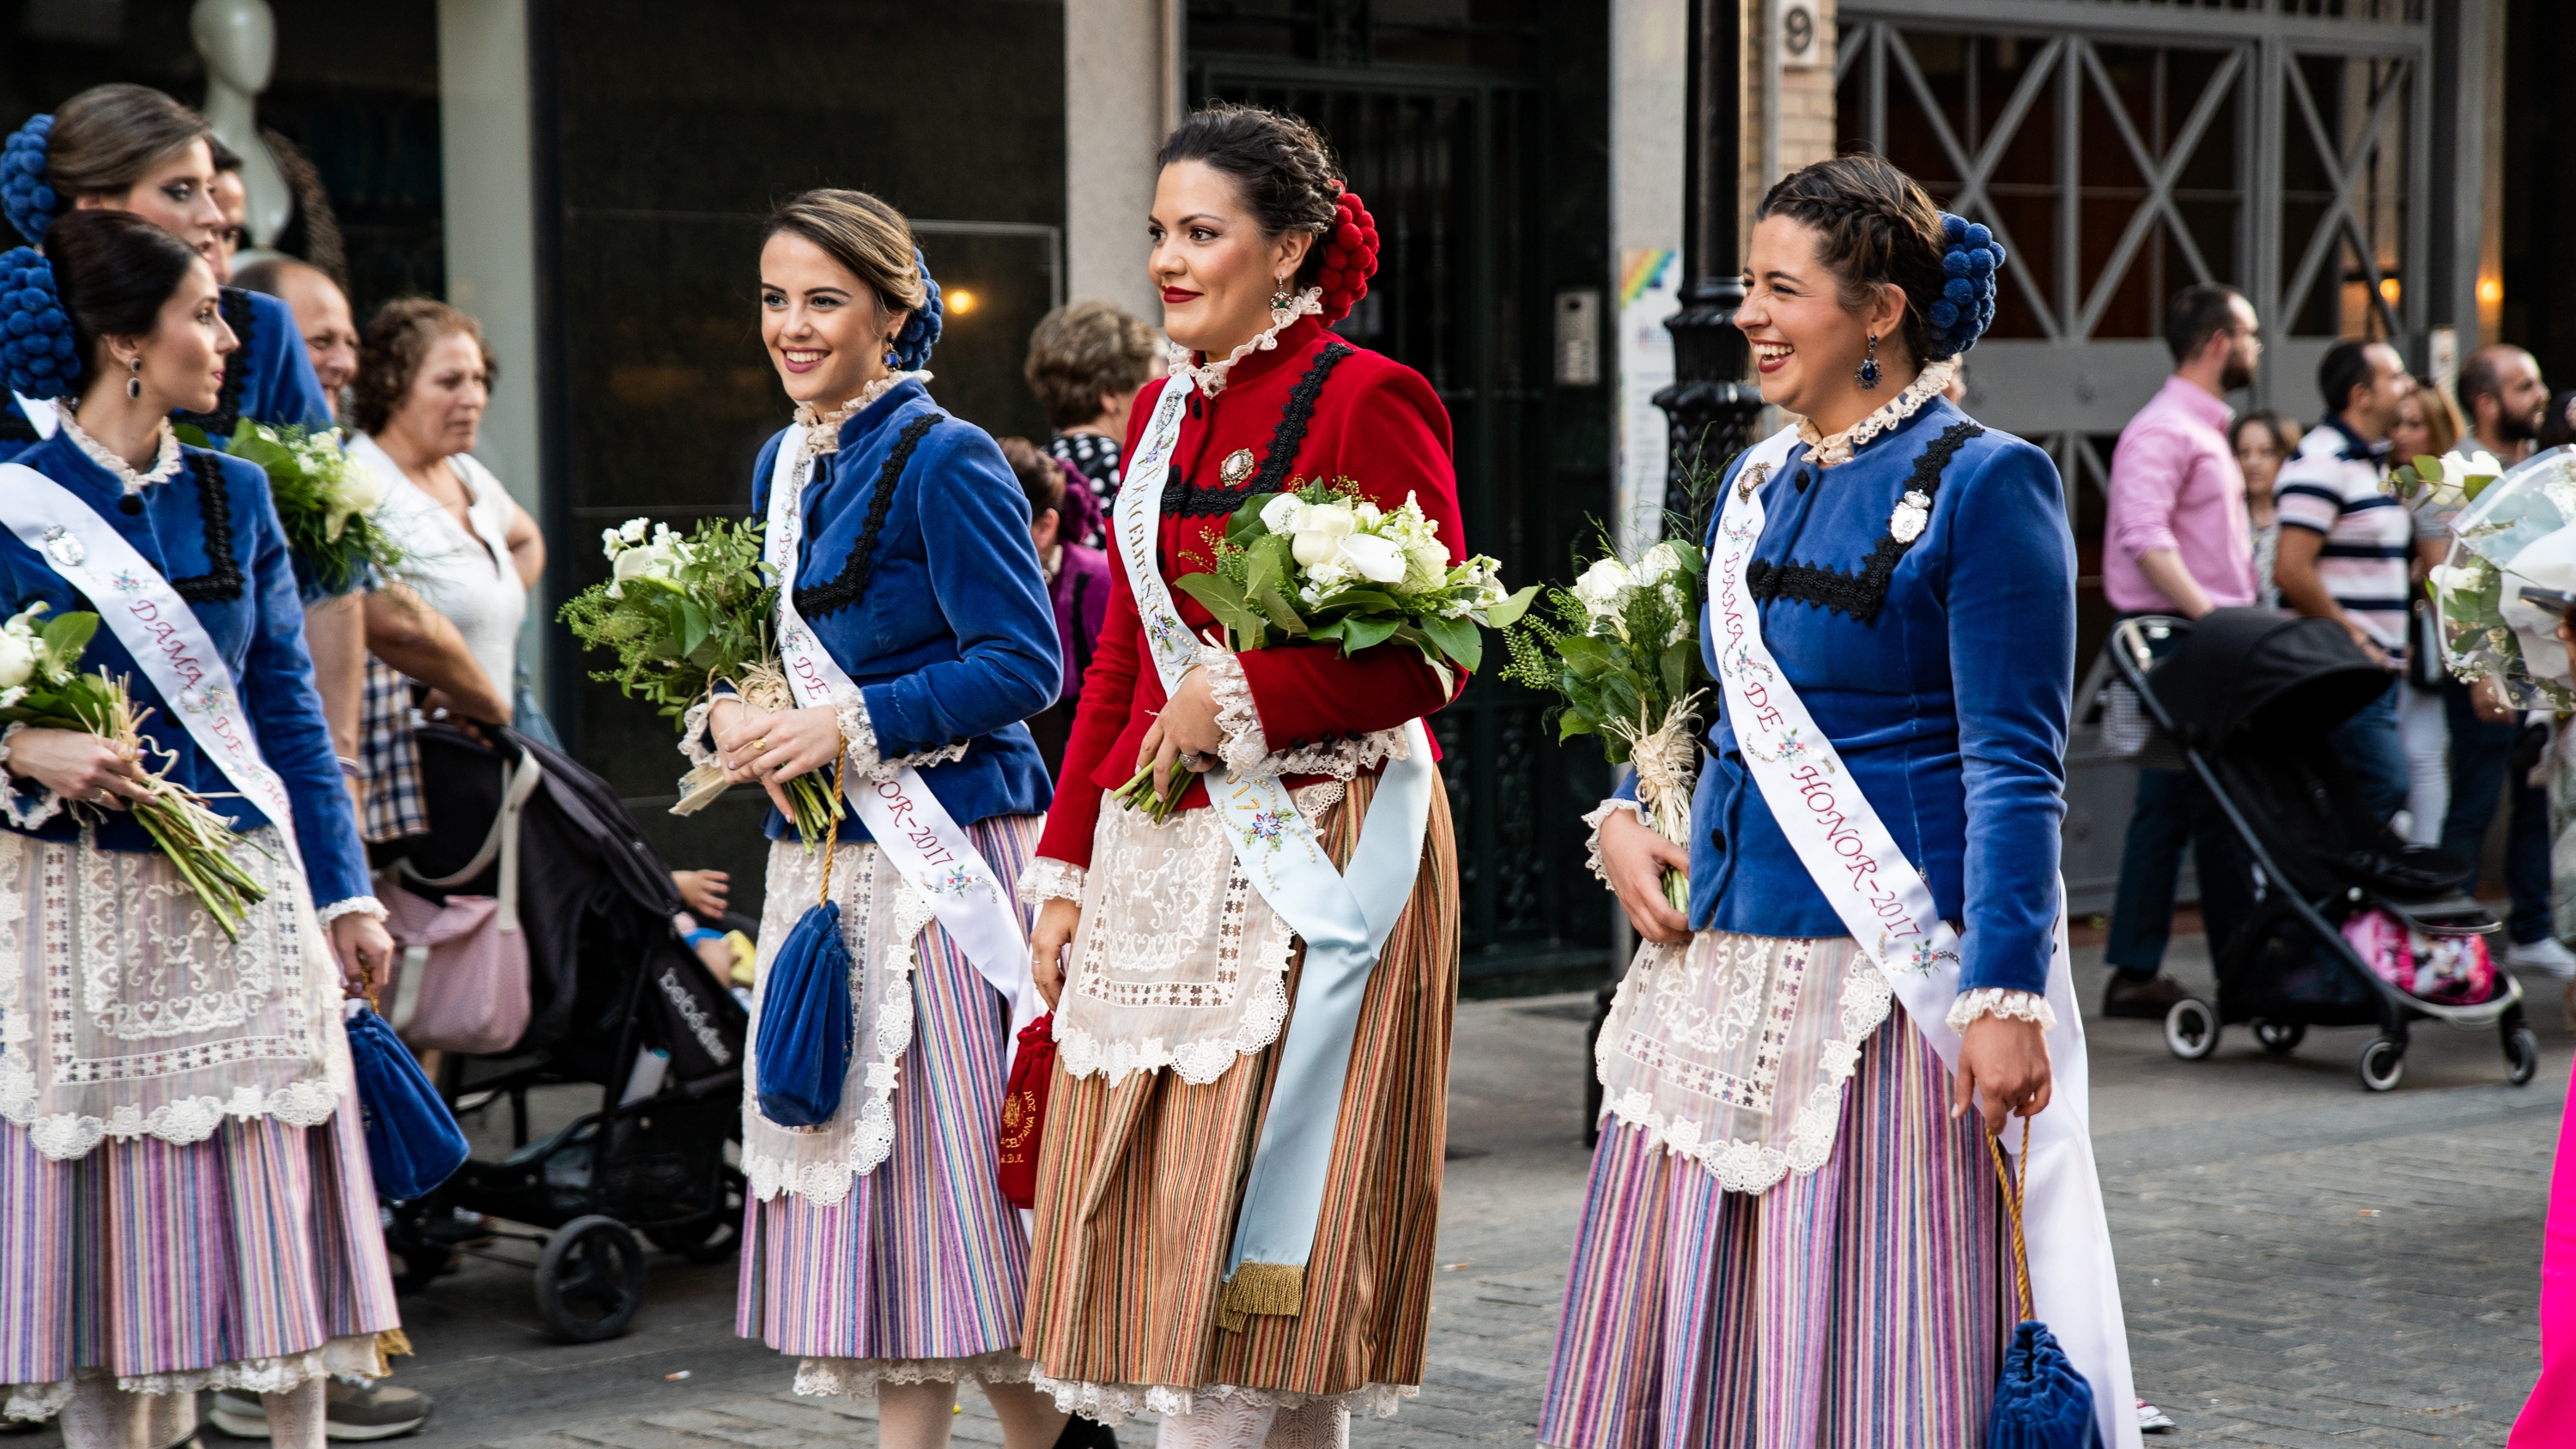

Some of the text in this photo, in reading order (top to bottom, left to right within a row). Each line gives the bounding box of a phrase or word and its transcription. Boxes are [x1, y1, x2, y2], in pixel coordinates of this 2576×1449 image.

[1785, 7, 1813, 57] 9
[129, 599, 204, 689] DAMA
[212, 716, 244, 758] DE
[793, 657, 830, 700] DE
[872, 779, 954, 865] OR-2017
[1722, 552, 1922, 938] DAMA DE HONOR-2017
